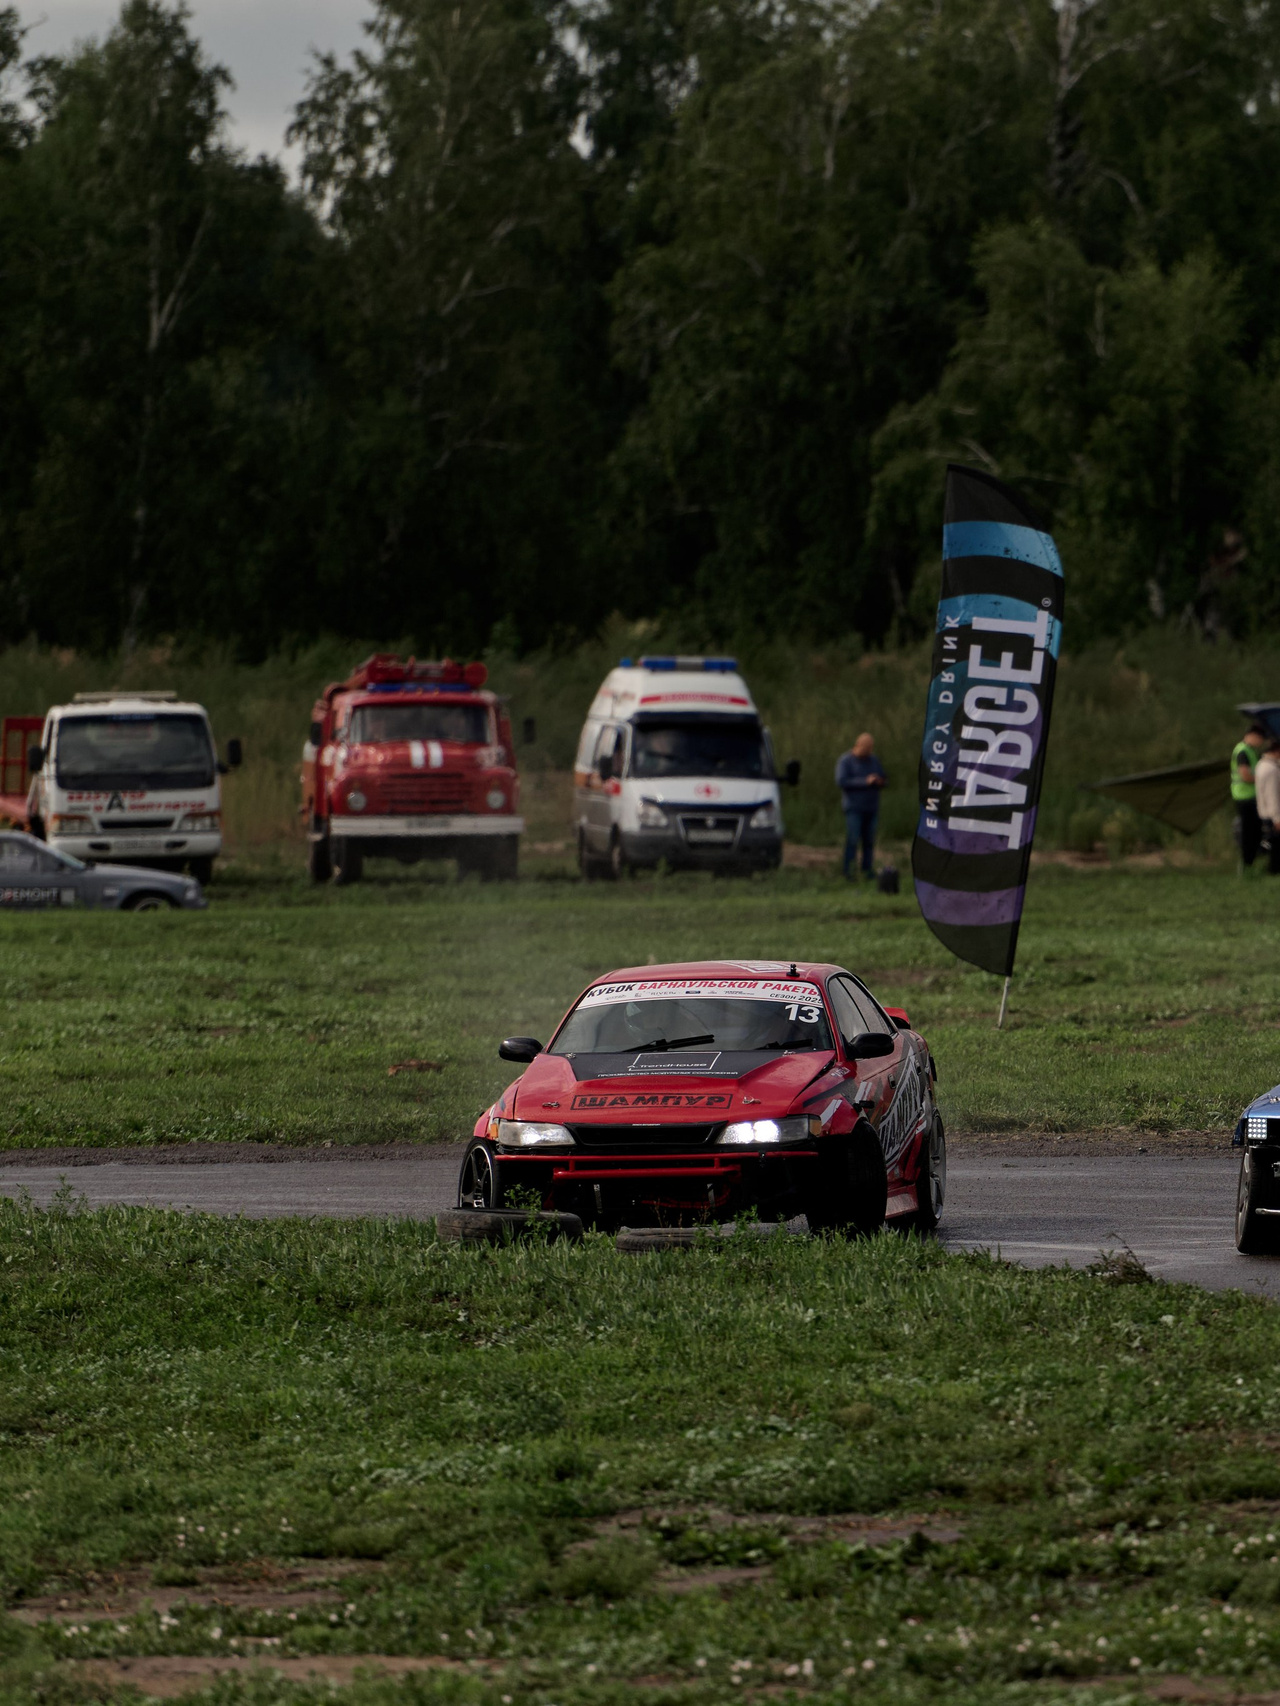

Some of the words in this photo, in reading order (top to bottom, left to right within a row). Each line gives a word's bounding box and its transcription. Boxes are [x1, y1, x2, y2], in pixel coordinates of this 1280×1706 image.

[587, 983, 636, 998] КУБОК
[638, 980, 758, 990] БАРНАУЛЬСКОЙ
[784, 1003, 820, 1024] 13
[578, 1096, 727, 1108] ШАМПУР
